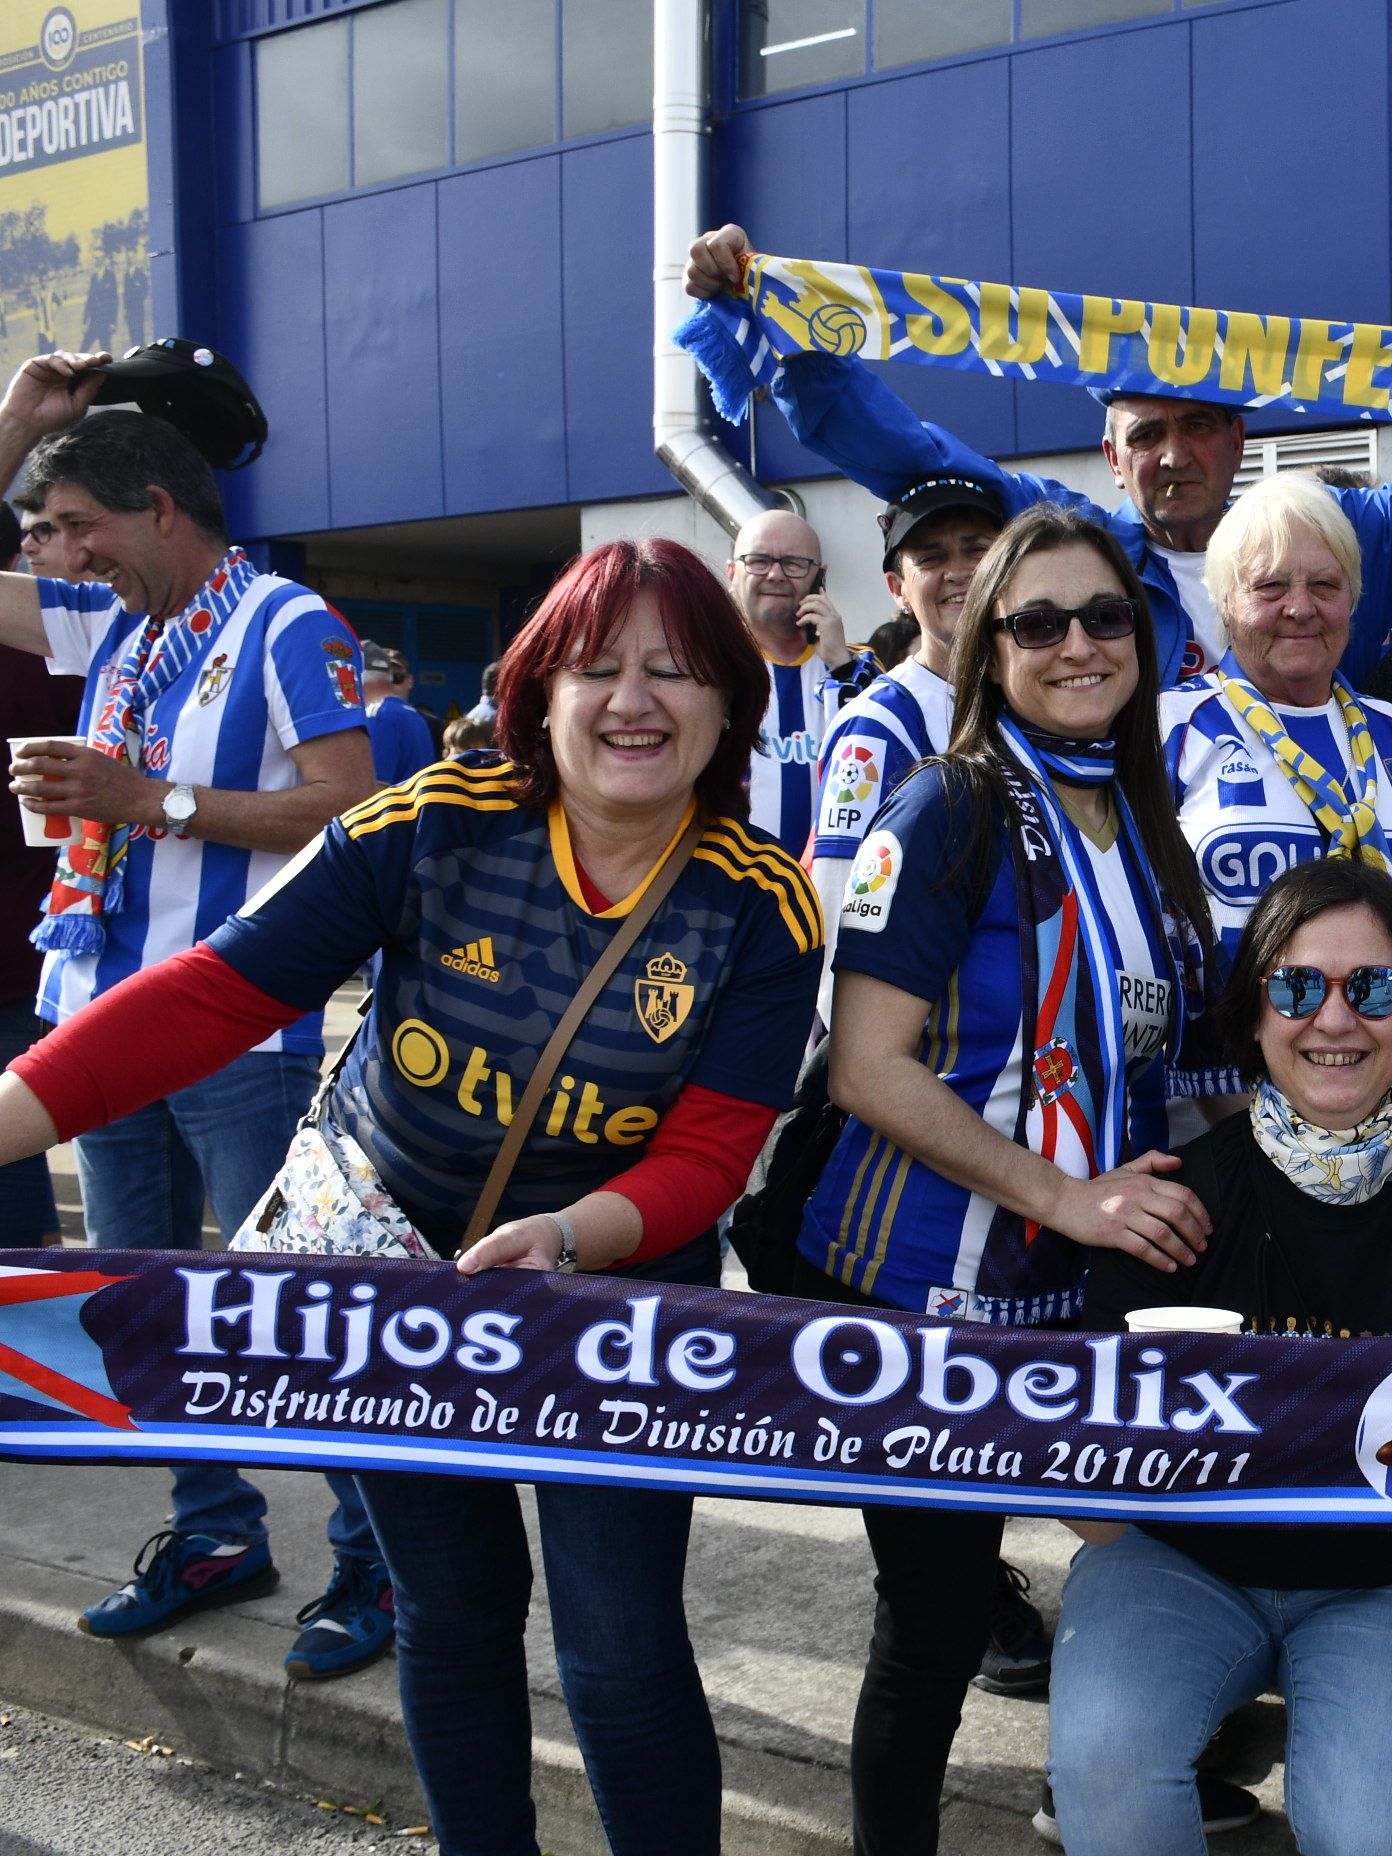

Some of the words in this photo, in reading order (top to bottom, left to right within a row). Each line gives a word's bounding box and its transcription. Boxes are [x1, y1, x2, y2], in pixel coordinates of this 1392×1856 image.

[0, 80, 135, 167] DEPORTIVA
[20, 79, 59, 105] AÑOS
[62, 60, 129, 92] CONTIGO
[905, 272, 1049, 364] SD
[827, 808, 862, 830] LFP
[440, 953, 500, 983] adidas
[177, 1268, 524, 1382] Hijos
[576, 1294, 738, 1391] de
[791, 1314, 1263, 1434] Obelix
[181, 1369, 456, 1430] Disfrutando
[470, 1387, 519, 1435] de
[535, 1393, 579, 1440] la
[599, 1398, 796, 1460] División
[813, 1416, 862, 1464] de
[882, 1424, 1024, 1480] Plata
[1039, 1439, 1251, 1491] 2010/11
